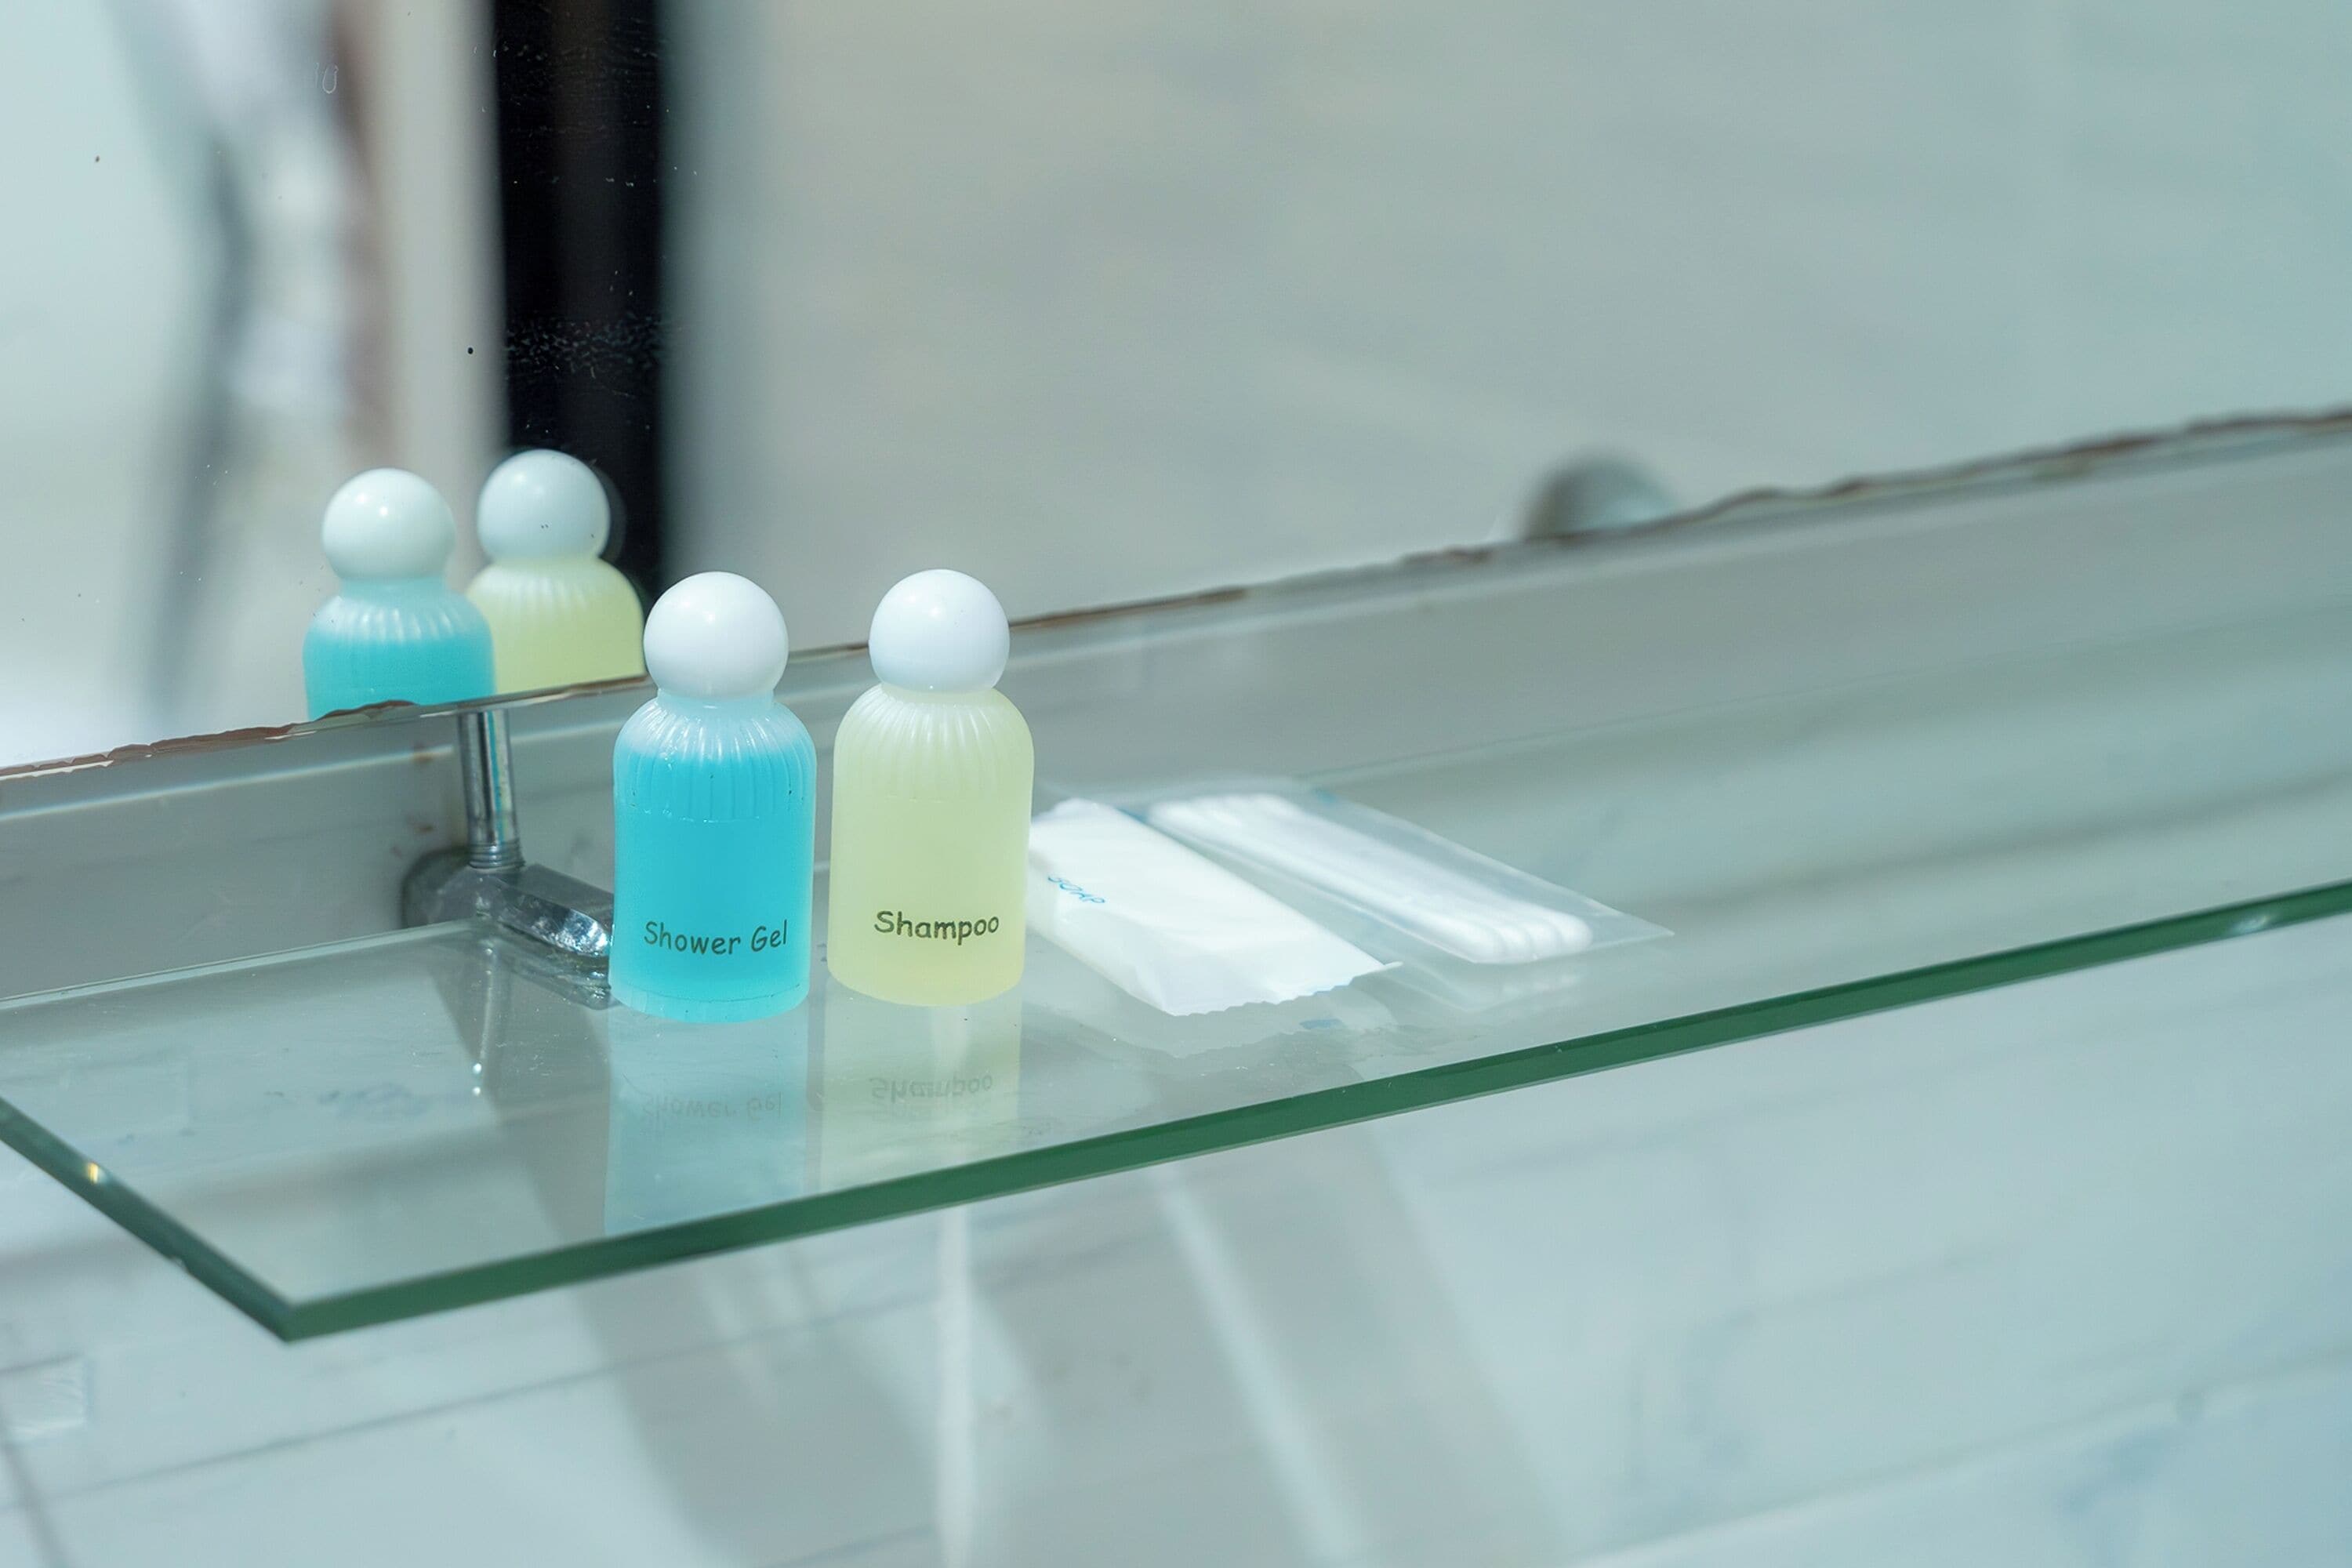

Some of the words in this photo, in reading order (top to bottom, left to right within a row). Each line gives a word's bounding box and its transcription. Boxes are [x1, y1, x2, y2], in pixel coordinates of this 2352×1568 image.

[644, 920, 741, 954] Shower
[750, 920, 787, 952] Gel
[874, 910, 1000, 946] Shampoo
